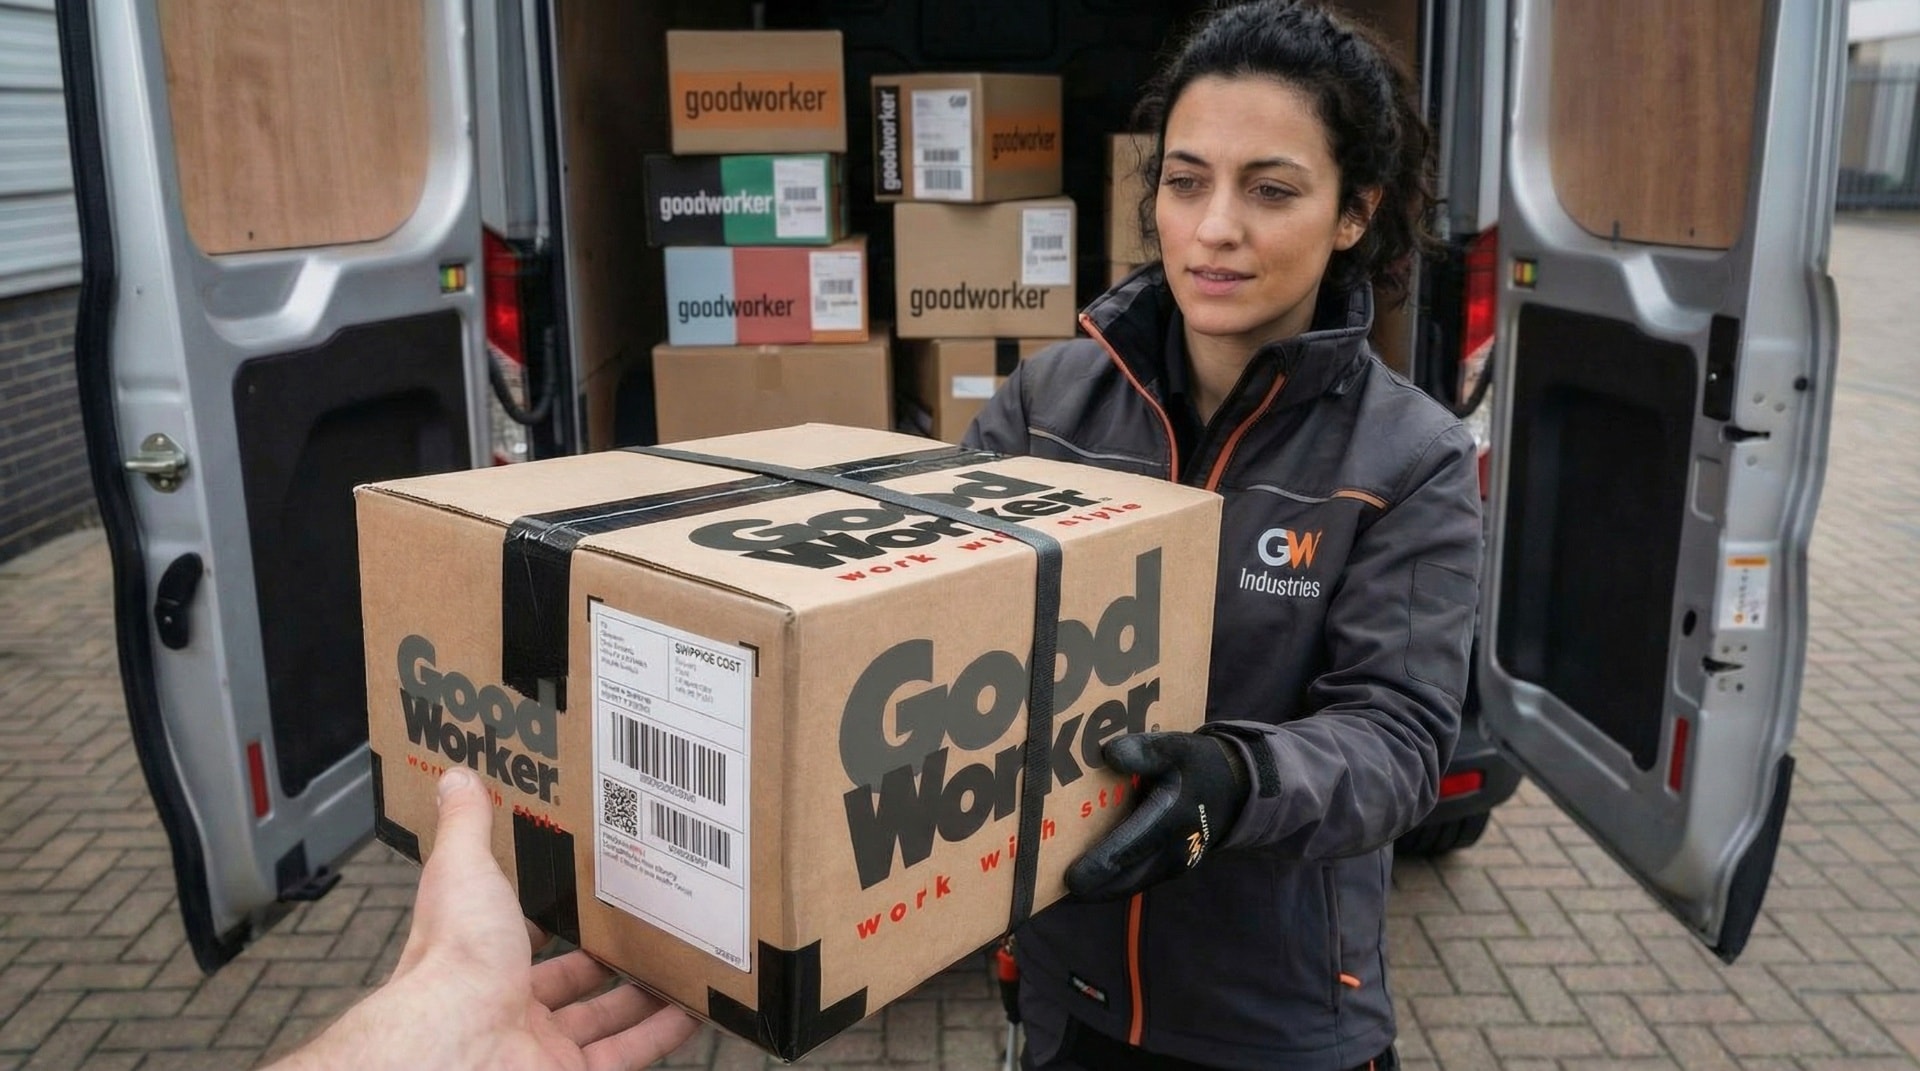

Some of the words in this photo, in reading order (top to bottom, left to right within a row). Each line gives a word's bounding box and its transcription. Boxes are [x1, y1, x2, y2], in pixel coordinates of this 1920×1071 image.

[685, 81, 827, 119] goodworker
[878, 90, 901, 190] goodworker
[992, 125, 1056, 160] goodworker
[659, 189, 774, 222] goodworker
[678, 294, 795, 324] goodworker
[910, 281, 1050, 317] goodworker
[836, 553, 937, 581] work
[1258, 528, 1322, 569] GW
[1240, 568, 1320, 597] Industries
[717, 656, 741, 673] COST
[839, 546, 1162, 794] Good
[397, 634, 558, 760] Good
[399, 687, 559, 803] Worker
[856, 876, 951, 939] work
[980, 818, 1056, 873] wih
